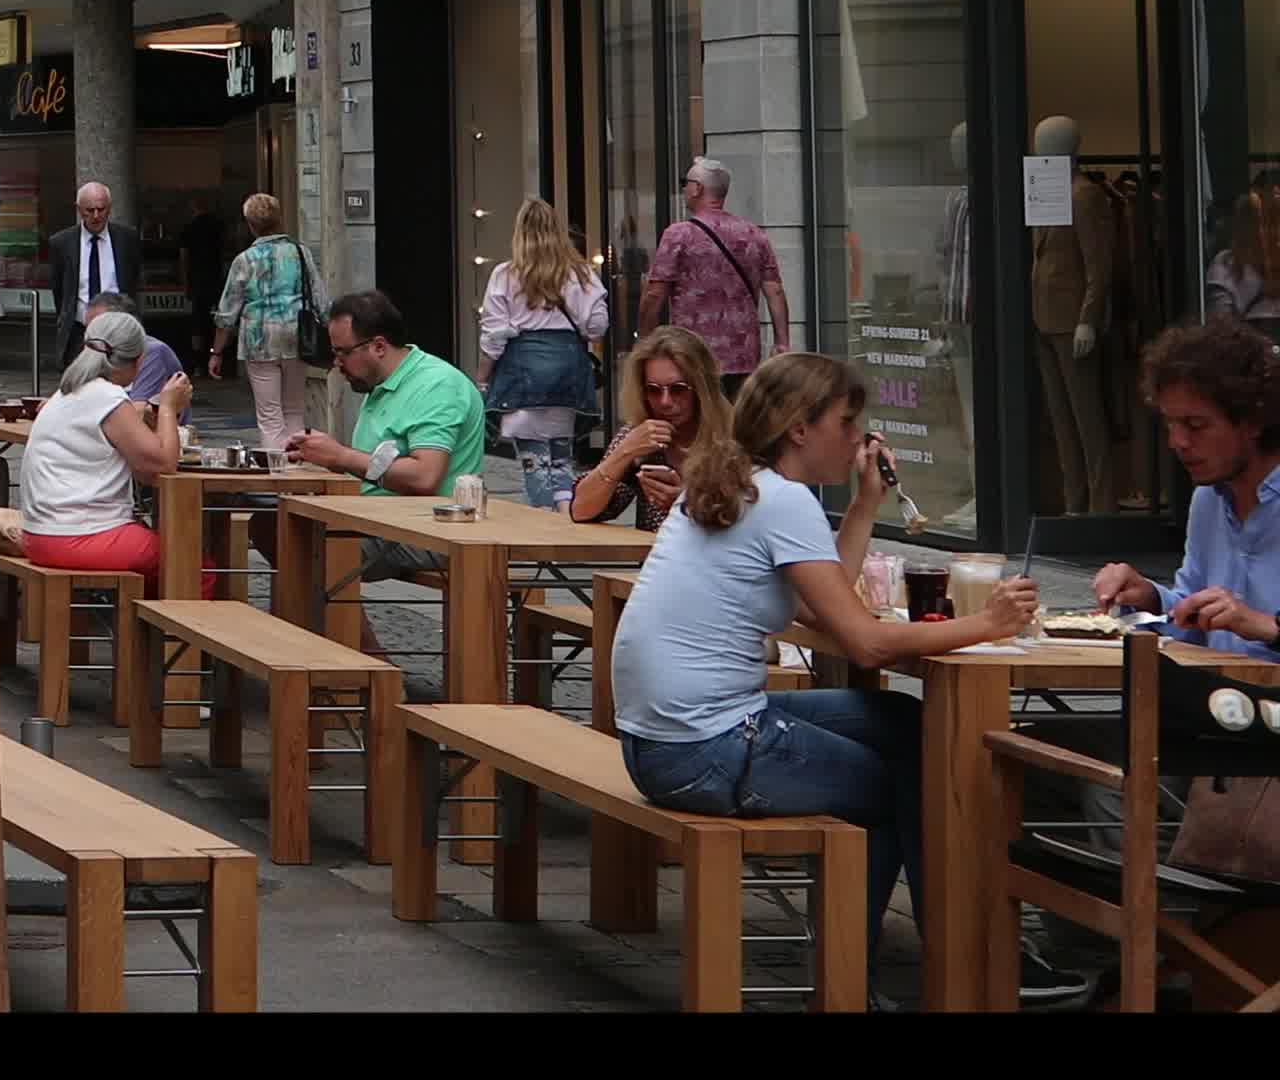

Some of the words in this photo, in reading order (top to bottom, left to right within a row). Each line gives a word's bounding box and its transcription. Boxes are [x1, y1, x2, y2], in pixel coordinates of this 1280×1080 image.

[348, 41, 362, 67] 33
[15, 68, 67, 124] Café
[879, 383, 918, 409] SALE
